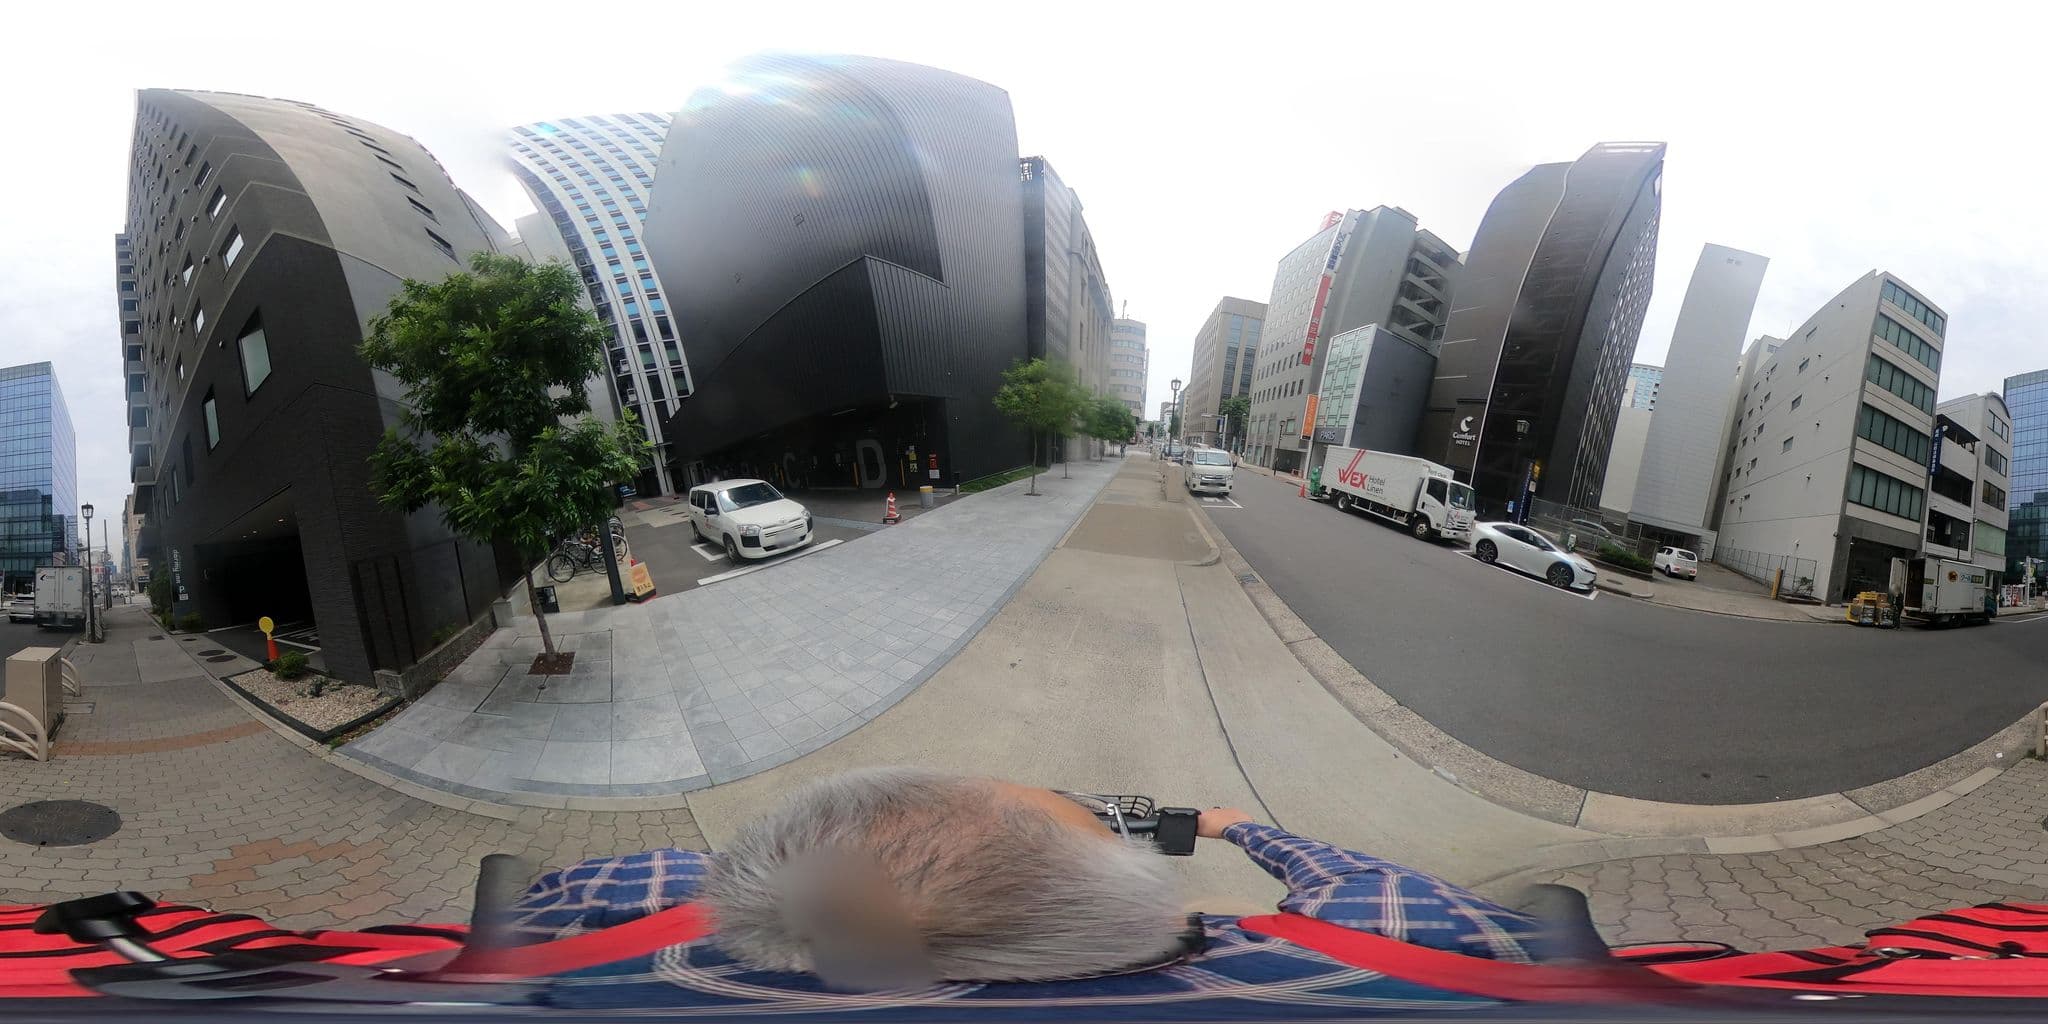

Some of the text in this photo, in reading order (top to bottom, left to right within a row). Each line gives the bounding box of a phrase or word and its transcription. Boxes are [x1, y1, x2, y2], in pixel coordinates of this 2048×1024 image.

[1452, 431, 1476, 441] Comfort
[856, 439, 887, 489] D
[1338, 451, 1369, 490] WEX
[1368, 474, 1386, 486] Hotel
[1366, 483, 1384, 494] Linen
[172, 549, 182, 573] dormy
[179, 585, 185, 594] P
